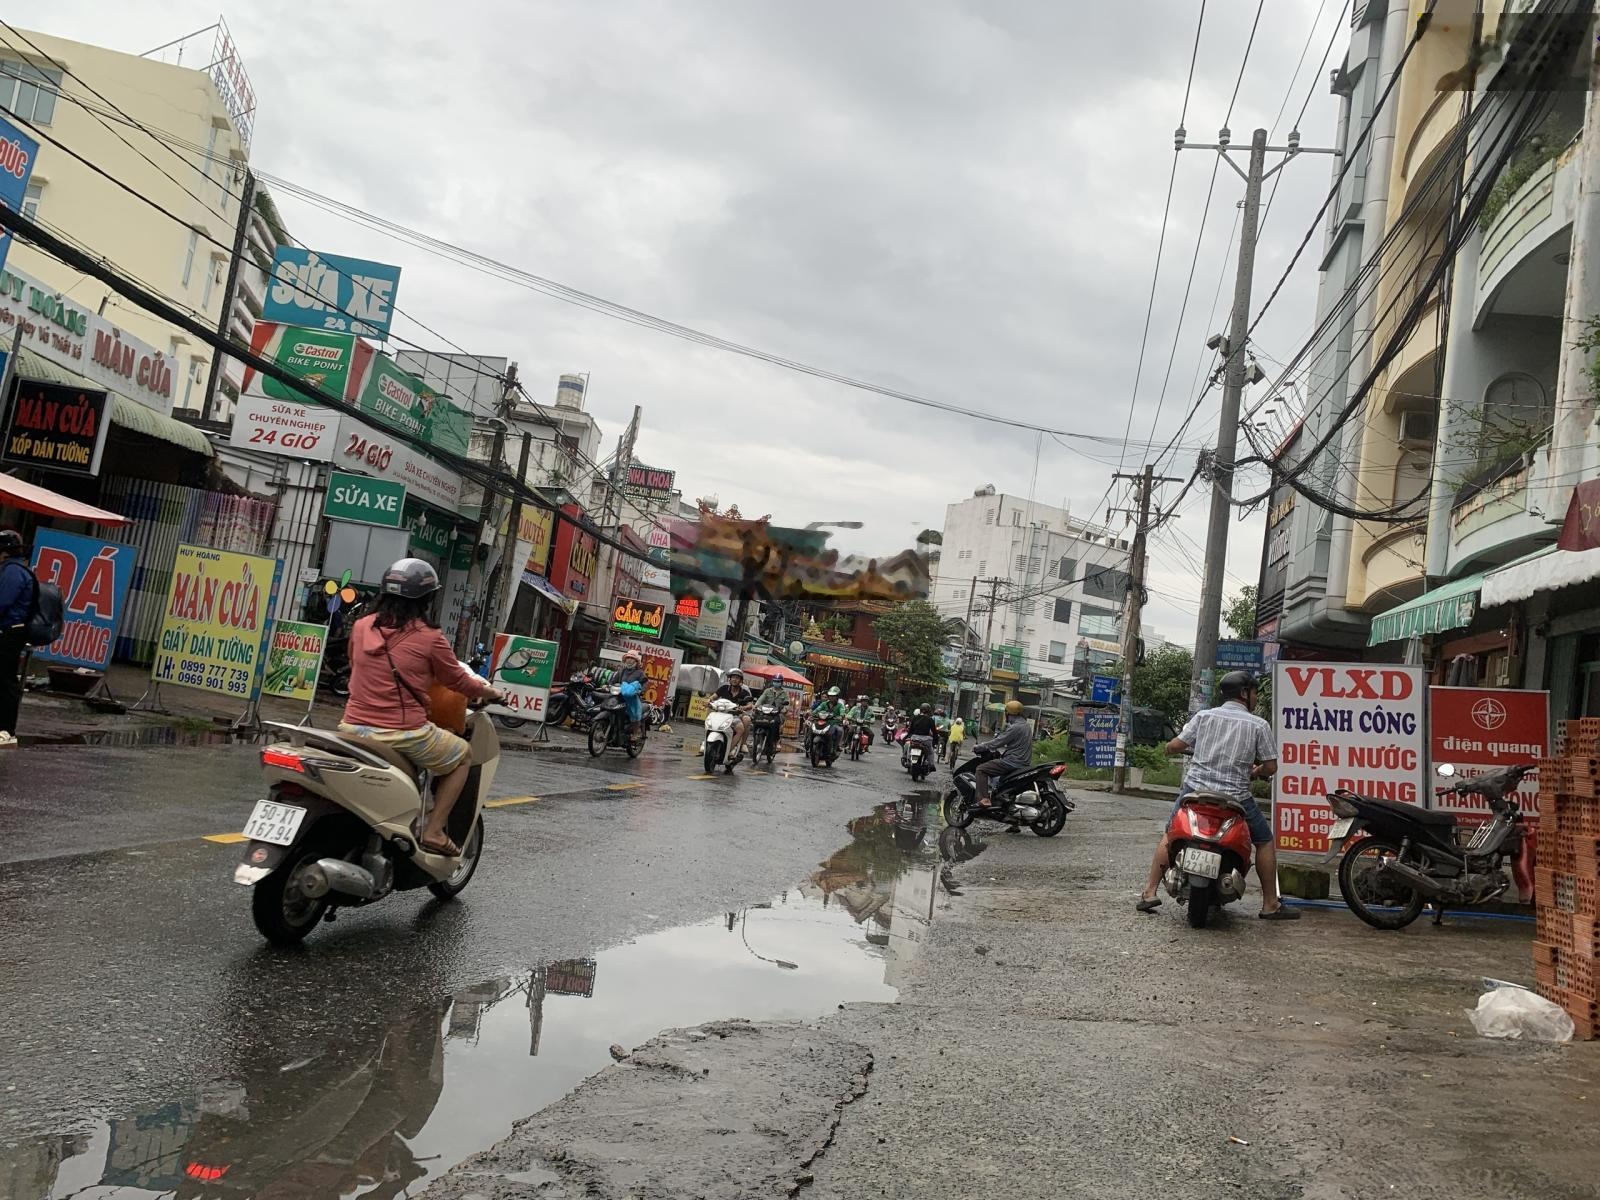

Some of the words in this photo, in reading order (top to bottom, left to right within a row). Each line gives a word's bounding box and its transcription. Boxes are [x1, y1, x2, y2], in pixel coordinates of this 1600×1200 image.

[271, 252, 339, 314] SỬA
[345, 273, 394, 323] XE
[323, 316, 347, 331] 24
[287, 356, 310, 367] BIKE
[312, 359, 345, 371] POINT
[303, 345, 341, 359] Castrol
[137, 350, 172, 398] CỬA
[385, 380, 413, 408] Castrol
[59, 393, 96, 437] CỬA
[248, 412, 289, 427] CHUYÊN
[290, 418, 326, 432] NGHIỆP
[294, 407, 306, 418] XE
[374, 398, 398, 421] BIKE
[400, 413, 426, 435] POINT
[10, 431, 32, 455] XỐP
[32, 436, 55, 459] DÁN
[56, 440, 91, 464] TƯỜNG
[248, 428, 276, 445] 24
[280, 431, 320, 450] GIỜ
[344, 433, 367, 459] 24
[628, 468, 646, 486] NHA
[646, 470, 670, 489] KHOA
[333, 483, 370, 507] SỬA
[374, 494, 399, 512] XE
[650, 489, 669, 499] MINH
[418, 524, 435, 543] TAY
[435, 529, 449, 548] GA
[650, 532, 668, 547] NHA
[180, 548, 195, 557] HUY
[32, 546, 119, 620] ĐÁ
[218, 561, 260, 633] CỬA
[161, 623, 190, 653] GIẤY
[190, 630, 215, 659] DÁN
[217, 635, 254, 665] TƯỜNG
[301, 634, 322, 655] MÍA
[622, 641, 643, 652] NHA
[645, 647, 671, 658] KHOA
[155, 654, 175, 680] LH:
[180, 659, 206, 674] 0899
[208, 664, 228, 678] 777
[230, 668, 249, 682] 739
[530, 657, 549, 665] POINT
[177, 671, 203, 686] 0969
[205, 677, 224, 690] 901
[227, 680, 247, 694] 993
[1284, 667, 1413, 701] VLXD
[524, 695, 544, 712] XE
[1282, 702, 1353, 733] THÀNH
[1358, 704, 1417, 736] CÔNG
[1282, 739, 1340, 770] ĐIỆN
[1348, 742, 1417, 771] NƯỚC
[1443, 736, 1483, 752] điện
[1486, 740, 1543, 758] quang
[1282, 776, 1328, 797] GIA
[1280, 807, 1305, 833] ĐT:
[1280, 836, 1303, 848] ĐC:
